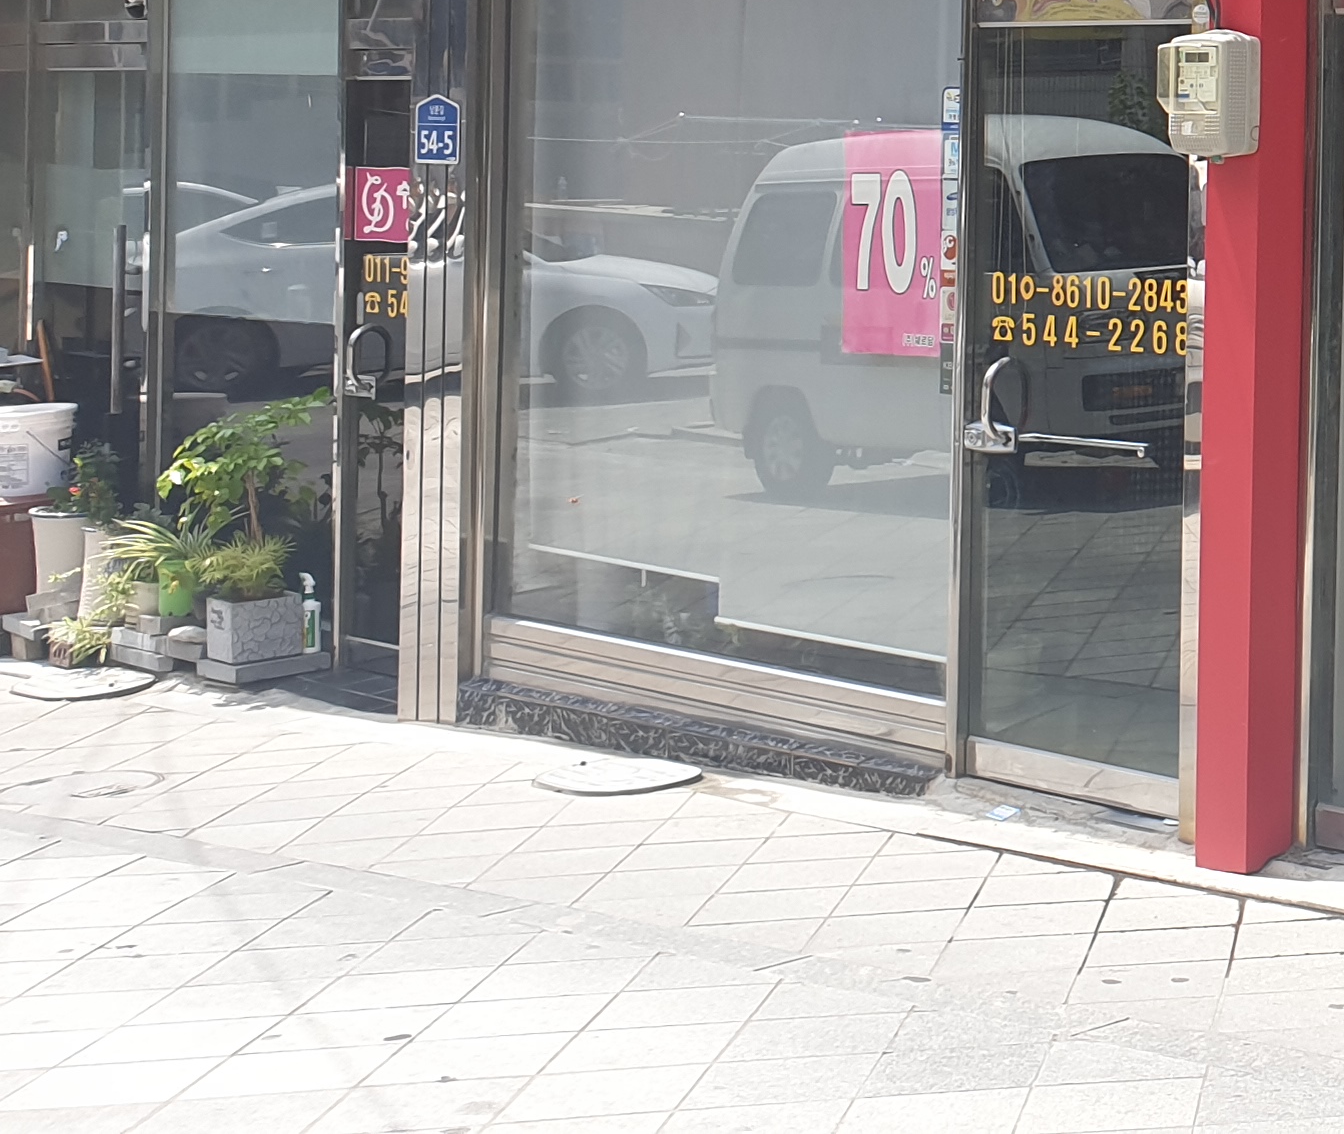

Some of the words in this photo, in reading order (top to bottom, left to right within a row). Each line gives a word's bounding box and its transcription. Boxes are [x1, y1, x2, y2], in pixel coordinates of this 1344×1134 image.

[420, 130, 453, 155] 54-5
[850, 169, 936, 299] 70%
[992, 271, 1187, 314] 010-8610-2843
[1022, 313, 1187, 356] 544-2268
